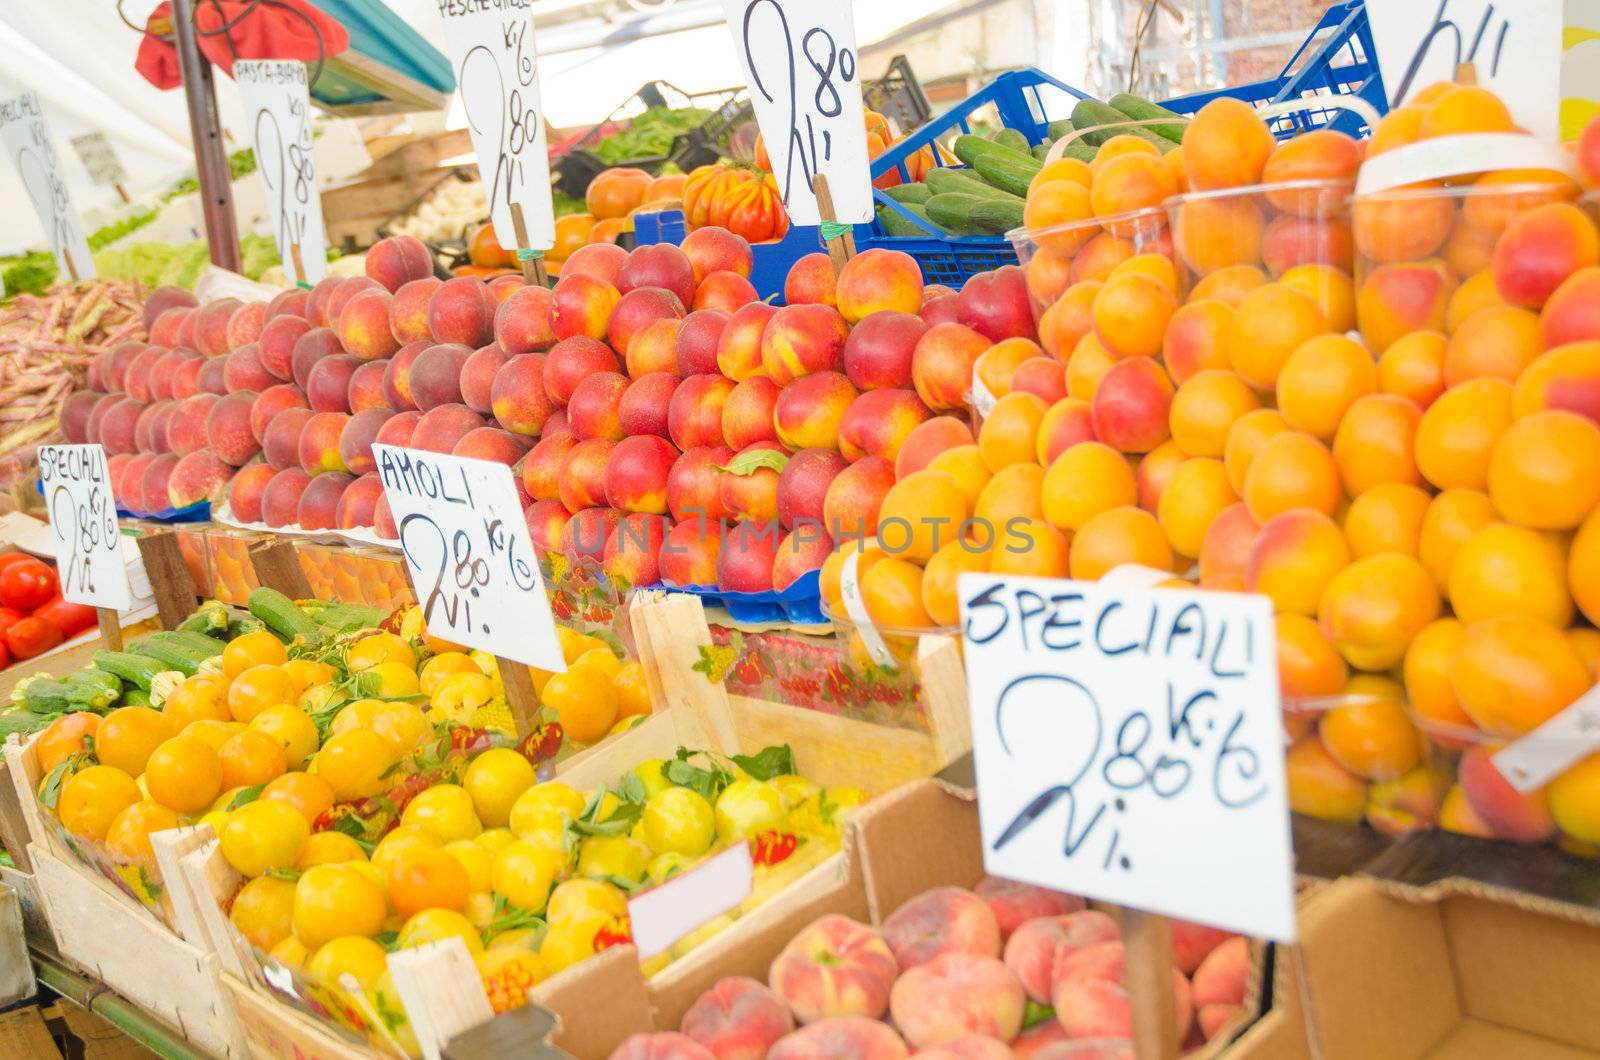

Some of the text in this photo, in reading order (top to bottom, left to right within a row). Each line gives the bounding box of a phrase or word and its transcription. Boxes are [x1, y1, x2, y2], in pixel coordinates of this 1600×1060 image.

[40, 446, 104, 485] SPECIALI
[381, 448, 475, 510] AMOLI
[966, 582, 1253, 677] SPECIALI
